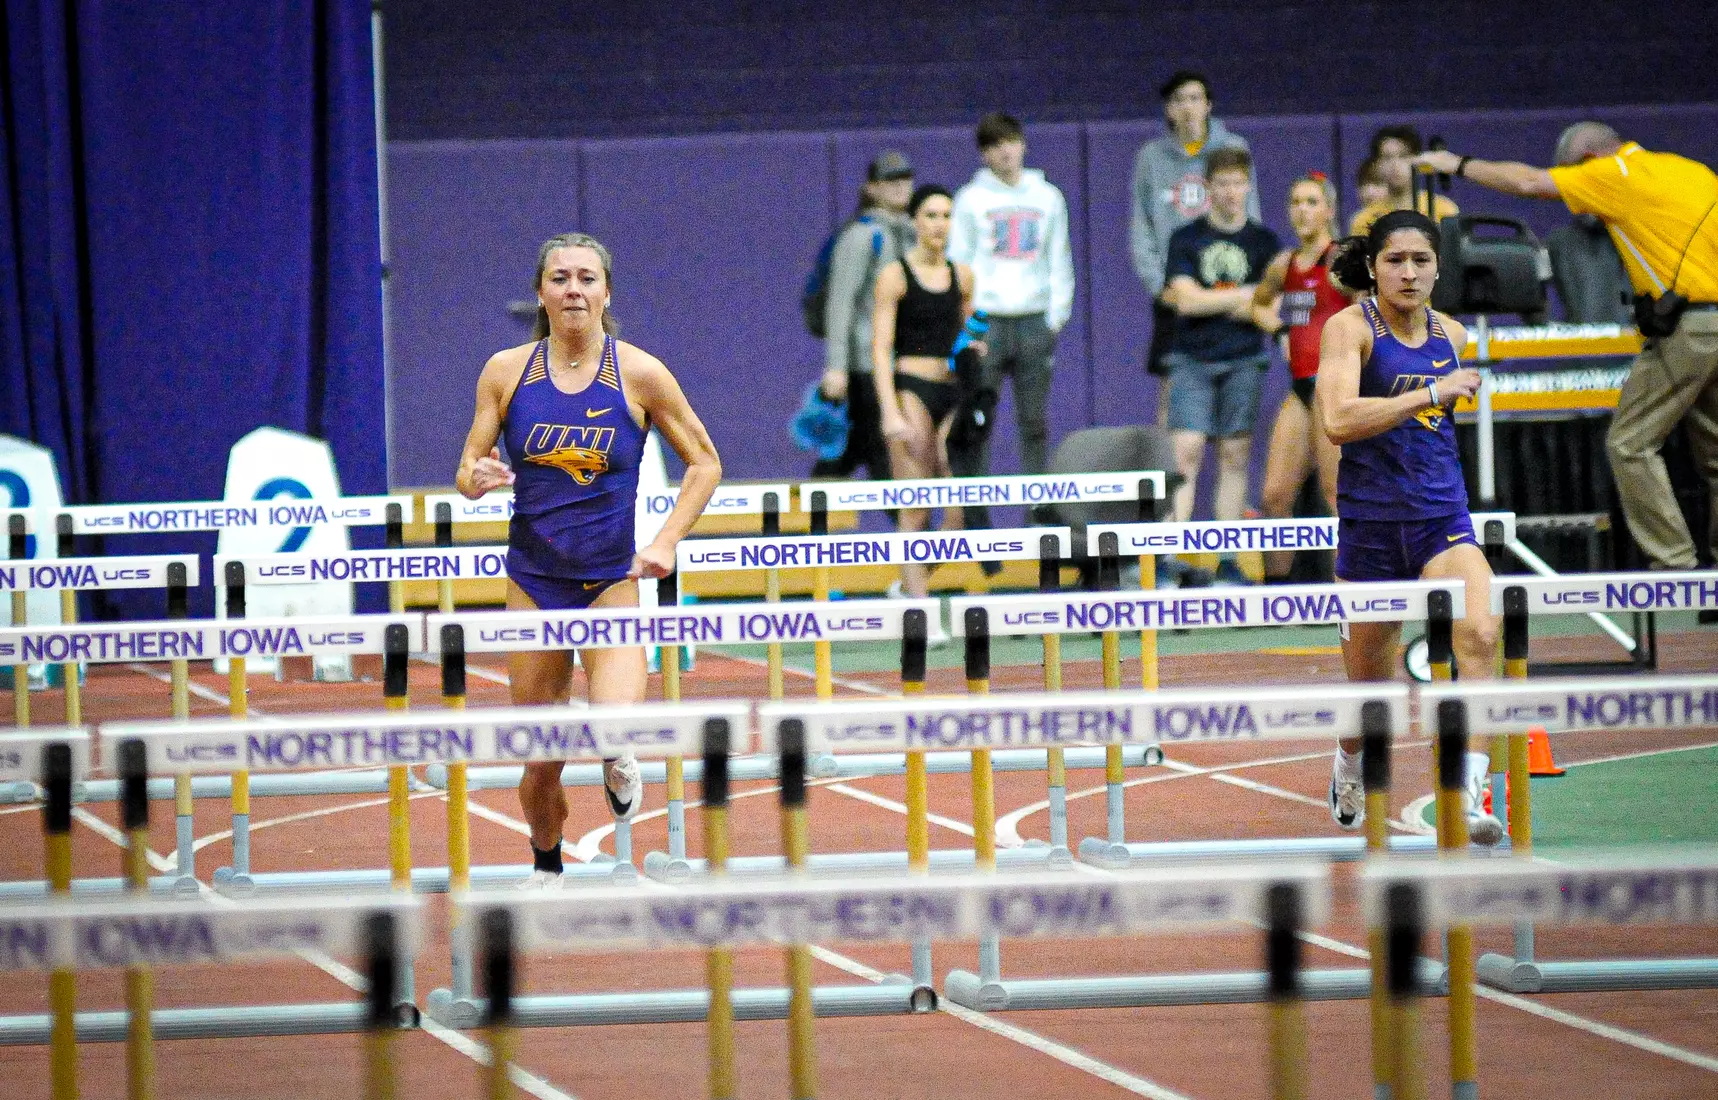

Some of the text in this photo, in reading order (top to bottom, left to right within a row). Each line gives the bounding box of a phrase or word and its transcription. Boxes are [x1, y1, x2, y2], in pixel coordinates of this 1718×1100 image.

[524, 423, 616, 457] UNI
[462, 504, 503, 515] UCS
[646, 495, 676, 514] IO
[838, 481, 1125, 506] UCS NORTHERN IOWA UCS
[84, 505, 371, 530] UCS NORTHERN IOWA UCS
[690, 538, 1024, 567] UCS NORTHERN IOWA UCS
[1132, 525, 1334, 551] UCS NORTHERN
[28, 564, 100, 589] IOWA
[103, 569, 151, 581] UCS
[259, 554, 508, 581] UCS NORTHERN IO
[1004, 594, 1408, 630] UCS NORTHERN IOWA UCS
[1543, 590, 1601, 605] UCS
[20, 629, 203, 661] NORTHERN
[219, 626, 304, 655] IOWA
[308, 631, 365, 645] UCS
[479, 612, 884, 646] UCS NORTHERN IOWA UCS
[904, 708, 1132, 747] NORTHERN
[1154, 703, 1259, 740] IOWA
[245, 727, 474, 767] NORTHERN
[494, 721, 598, 758] IOWA
[649, 890, 960, 945] NORTHERN
[985, 886, 1126, 938] IOWA
[75, 911, 218, 967] IOWA
